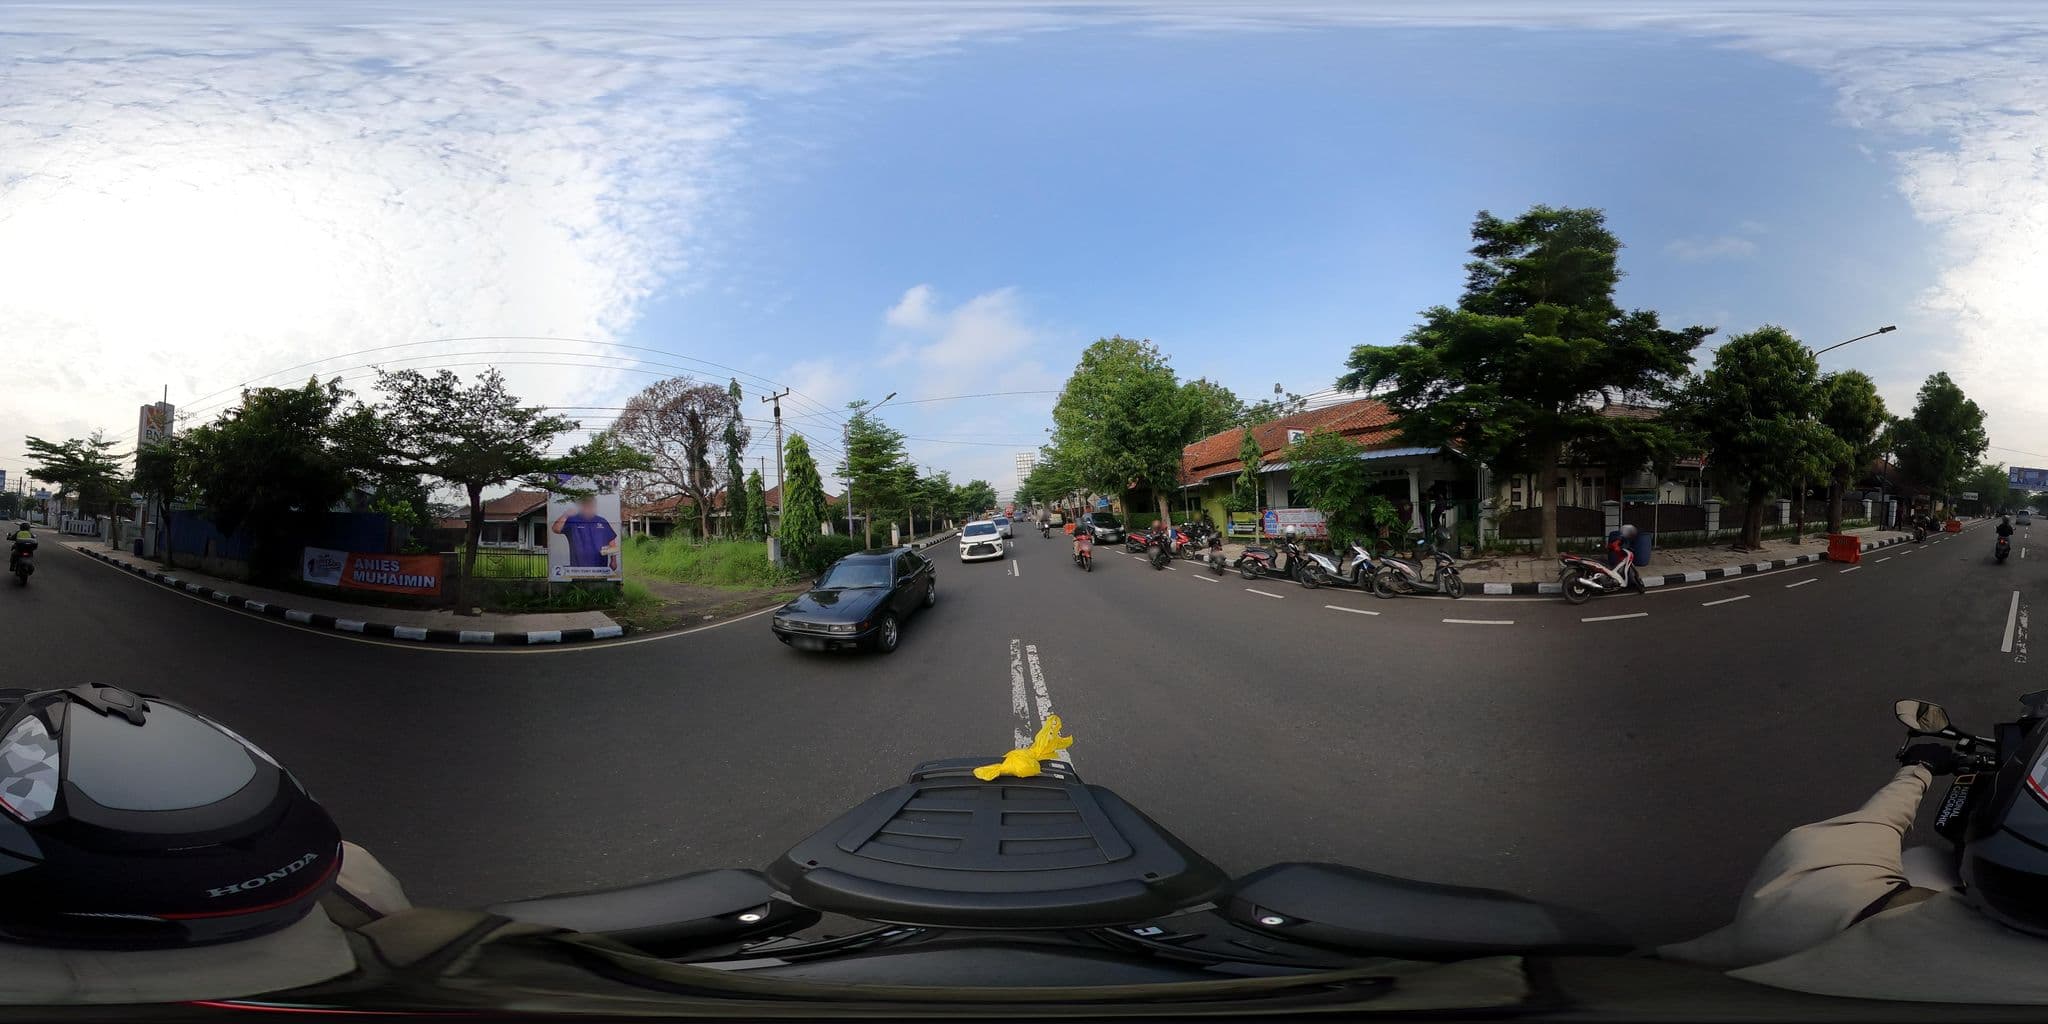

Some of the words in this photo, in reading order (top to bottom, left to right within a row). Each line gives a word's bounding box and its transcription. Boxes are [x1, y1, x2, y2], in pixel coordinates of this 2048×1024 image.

[146, 429, 164, 442] BN
[354, 558, 400, 572] ANIES
[555, 566, 561, 576] 2
[353, 571, 436, 588] MUHAIMIN
[1949, 786, 1969, 819] NATIONAL
[206, 852, 320, 898] HONDA
